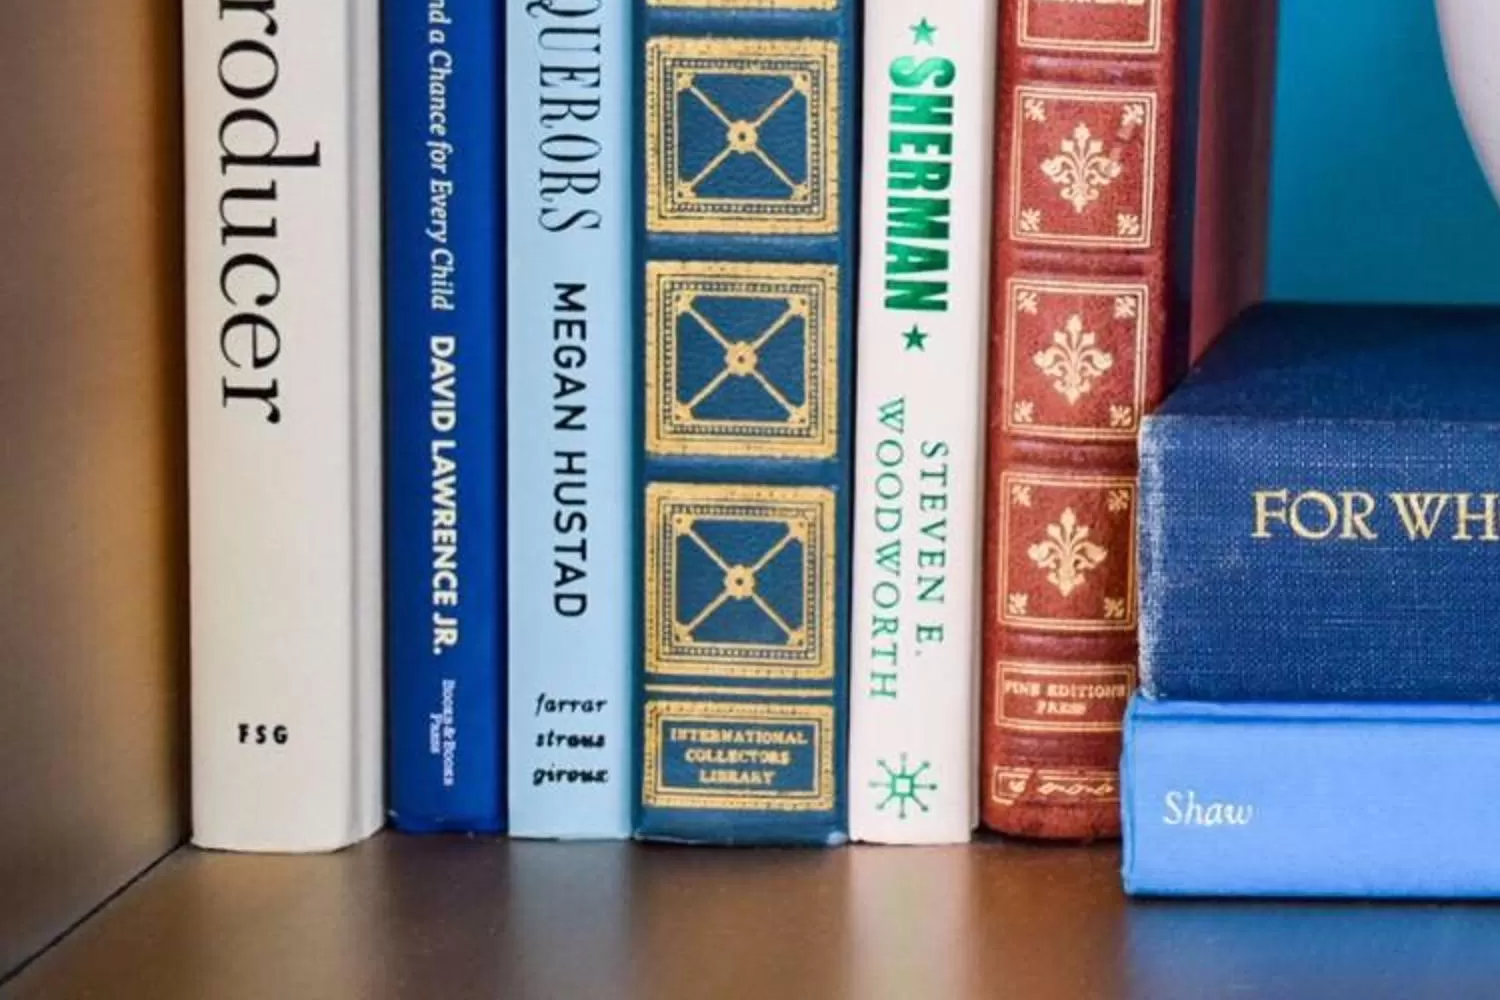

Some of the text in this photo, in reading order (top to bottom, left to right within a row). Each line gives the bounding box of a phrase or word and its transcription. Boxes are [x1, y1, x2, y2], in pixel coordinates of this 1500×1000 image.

[428, 29, 446, 44] a
[428, 49, 453, 137] Chance
[425, 140, 454, 175] for
[883, 59, 956, 312] SHERMAN
[425, 178, 454, 244] Every
[430, 247, 455, 311] Child
[553, 282, 588, 617] MEGAN HUSTAD
[430, 335, 459, 655] DAVID LAWRENCE JR.
[1250, 487, 1378, 541] FOR
[869, 396, 905, 699] WOODWORTH
[915, 441, 949, 656] STEVEN E.
[670, 727, 809, 745] INTERNATIONAL
[699, 769, 776, 786] LIBRARY
[1162, 790, 1256, 828] Shaw
